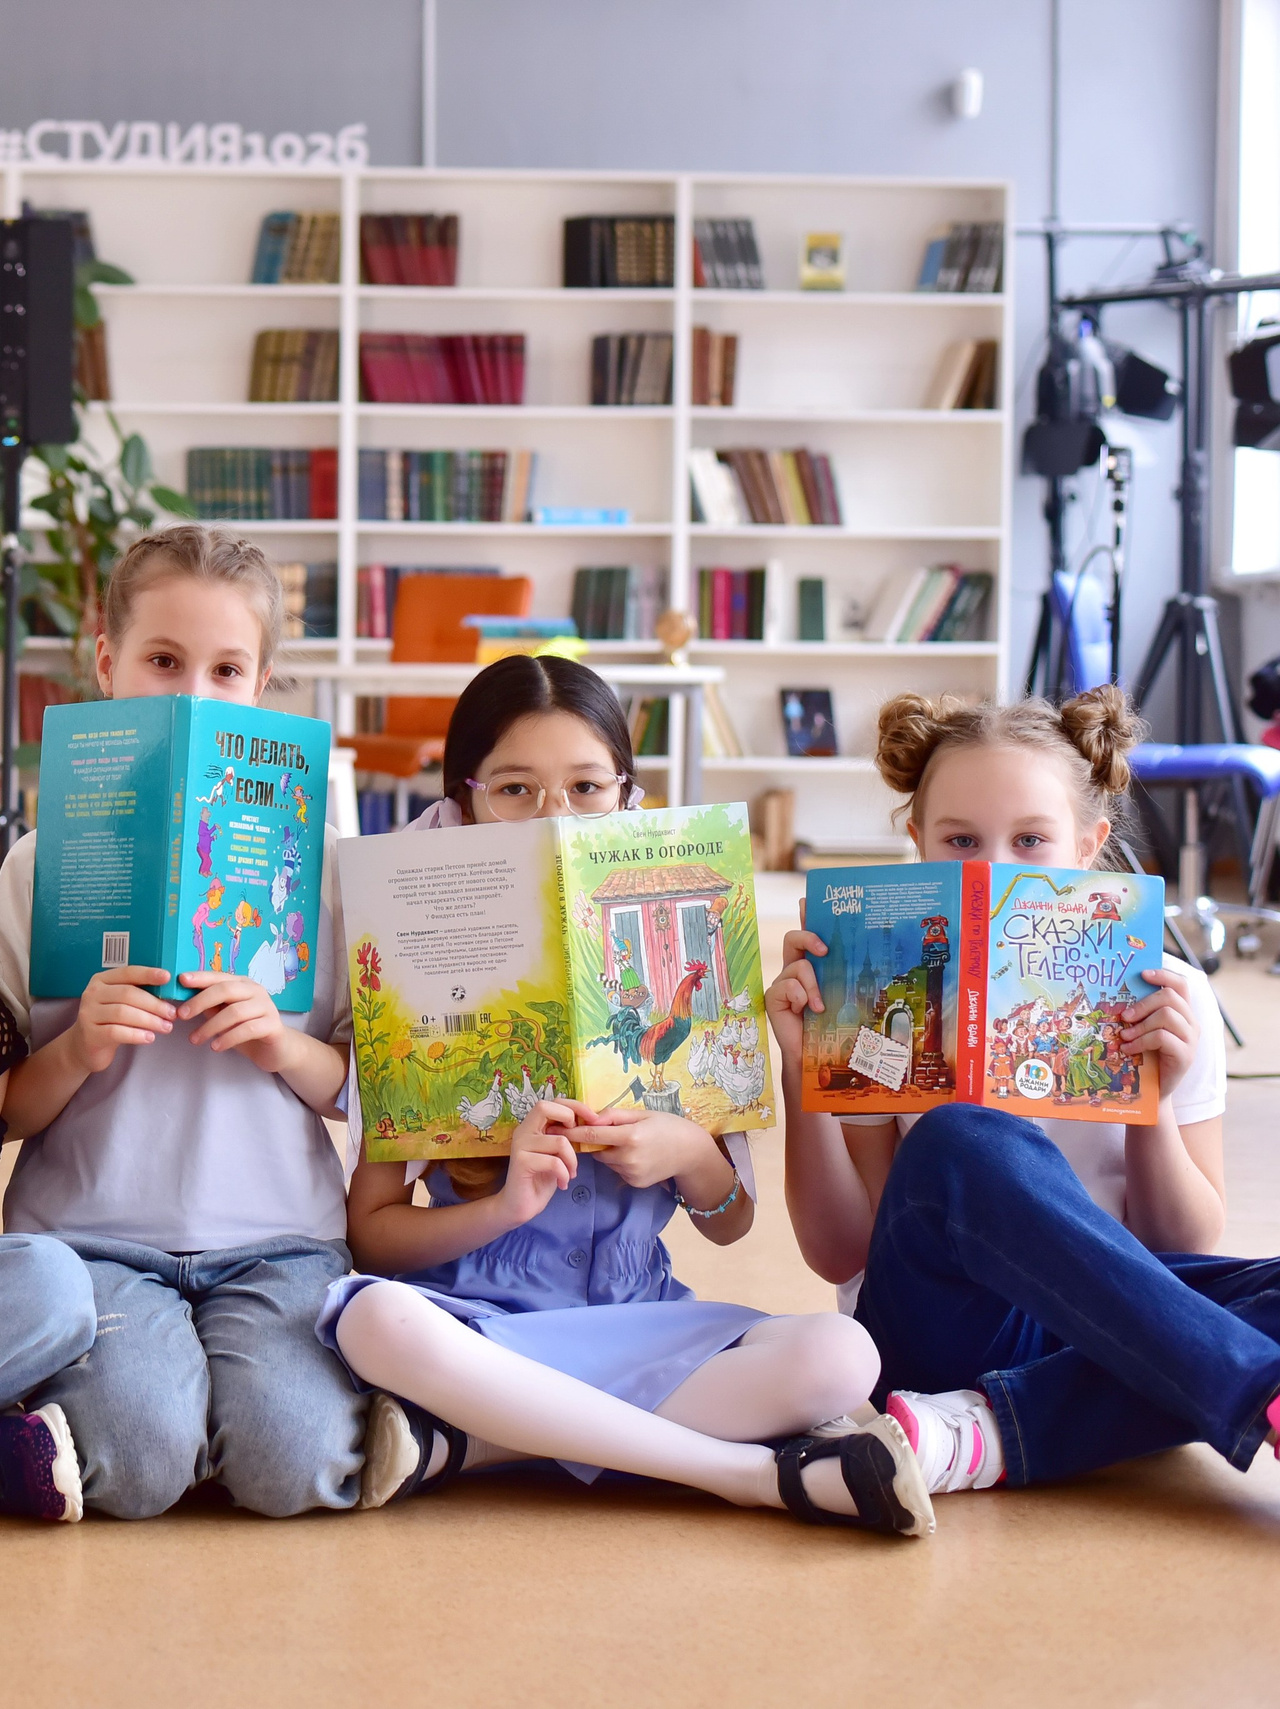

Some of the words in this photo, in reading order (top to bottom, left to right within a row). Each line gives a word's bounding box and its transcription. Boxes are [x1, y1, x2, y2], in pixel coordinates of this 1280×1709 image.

[216, 731, 244, 760] ЧТО
[249, 737, 310, 774] ДЕЛАТЬ,
[236, 778, 289, 810] ЕСЛИ...
[633, 831, 646, 839] Свен
[648, 829, 676, 838] Нурдквист
[589, 849, 640, 864] ЧУЖАК
[646, 848, 654, 860] В
[659, 842, 724, 859] ОГОРОДЕ
[387, 875, 418, 884] огромного
[469, 869, 493, 877] Котёнок
[494, 867, 516, 876] Финдус
[396, 866, 423, 876] Однажды
[424, 866, 443, 874] старик
[444, 863, 465, 871] Петсон
[466, 861, 487, 870] принёс
[488, 860, 507, 869] домой
[556, 855, 564, 893] ОГОРОДЕ
[392, 890, 417, 899] который
[438, 888, 463, 896] завладел
[464, 885, 498, 893] вниманием
[499, 884, 509, 892] кур
[432, 881, 456, 889] восторге
[424, 897, 455, 906] кукарекать
[823, 885, 864, 903] ДЖАННИ
[968, 881, 984, 920] СКАЗКИ
[169, 894, 178, 916] ЧТО
[433, 904, 444, 912] Что
[832, 900, 862, 915] РОДАРИ
[1011, 898, 1052, 911] ДЖАННИ
[1058, 902, 1088, 914] РОДАРИ
[430, 912, 455, 921] Финдуса
[410, 928, 439, 937] Нурдквист
[1003, 914, 1113, 954] СКАЗКИ
[563, 943, 572, 980] НУРДКВИСТ
[967, 940, 983, 978] ТЕЛЕФОНУ
[1052, 946, 1080, 963] ПО
[1008, 942, 1135, 987] ТЕЛЕФОНУ
[967, 988, 980, 1020] ДЖАННИ
[421, 1015, 436, 1025] 0+
[967, 1024, 978, 1047] РОДАРИ
[1024, 1064, 1048, 1081] 100
[1019, 1078, 1049, 1088] ДЖАННИ
[1020, 1083, 1047, 1093] РОДАРИ
